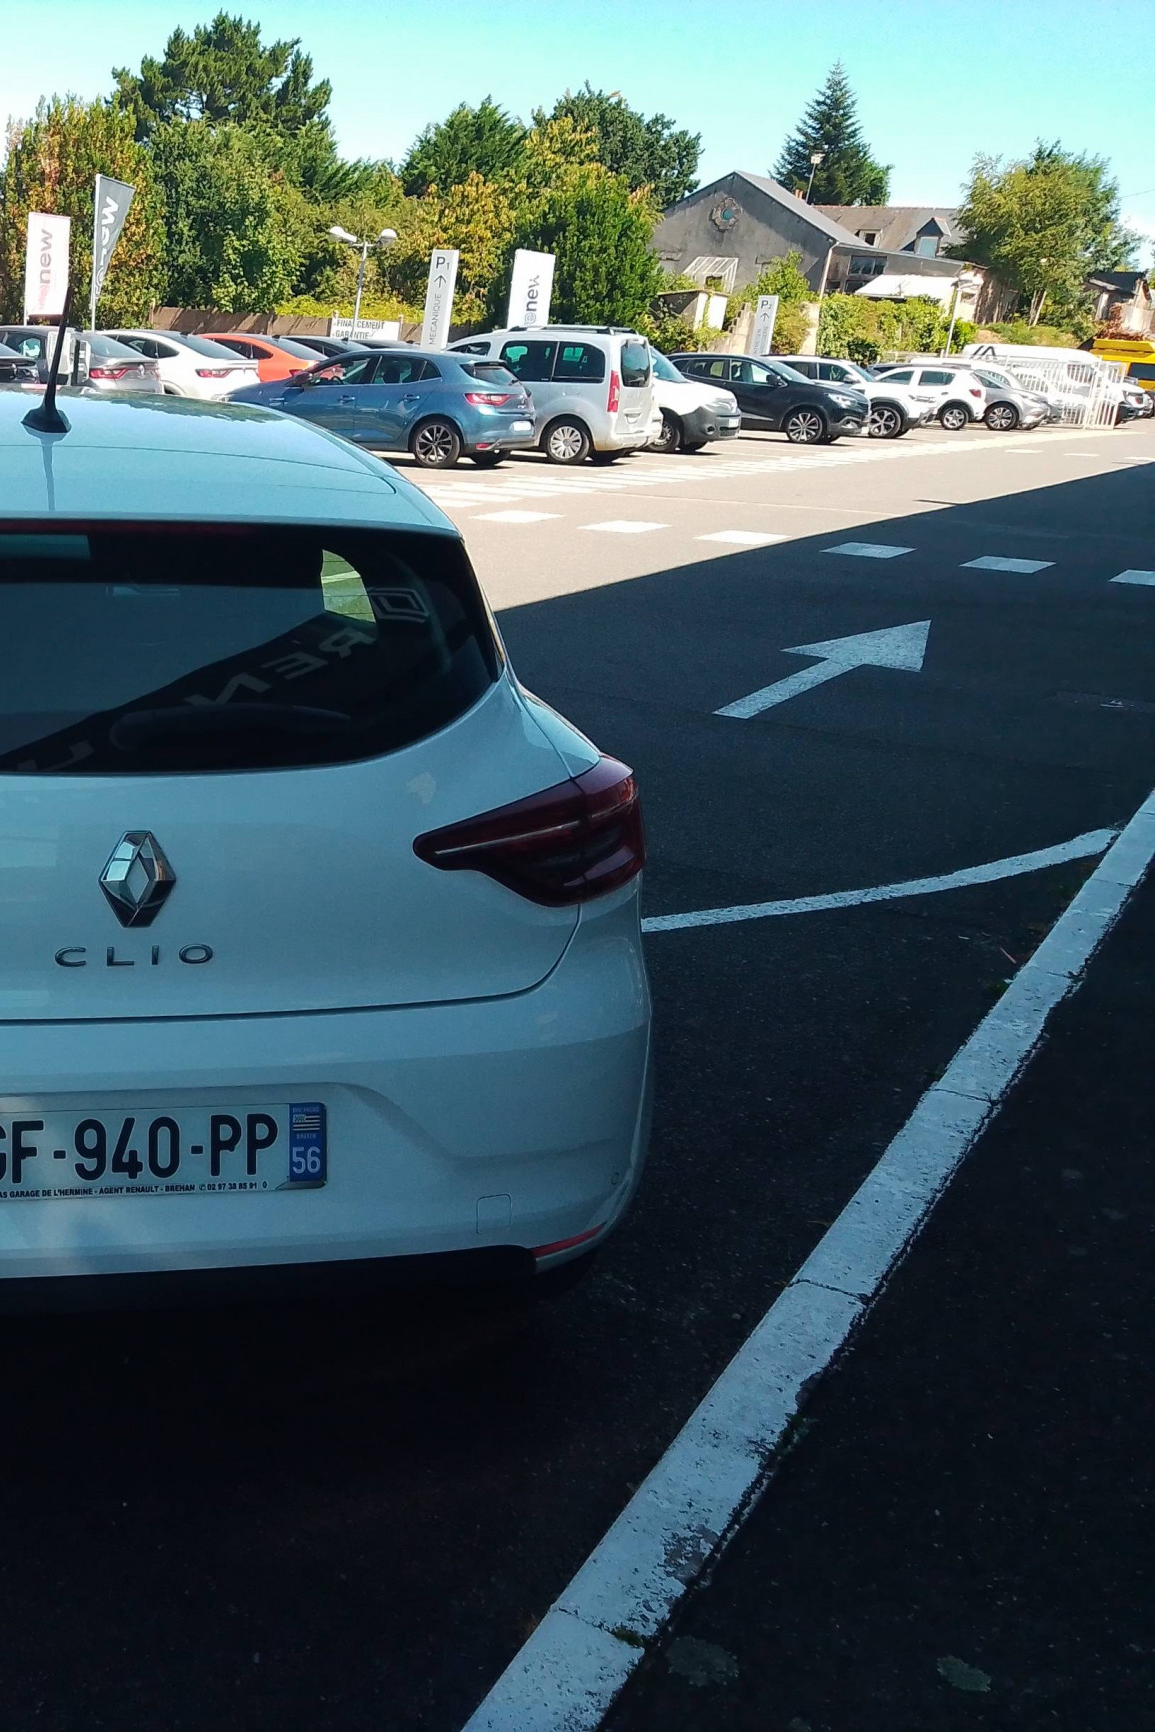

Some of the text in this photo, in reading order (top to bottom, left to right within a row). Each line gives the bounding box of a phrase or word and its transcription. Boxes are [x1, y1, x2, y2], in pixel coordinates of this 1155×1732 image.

[336, 319, 385, 330] FINACEMENT
[428, 292, 443, 345] MECANIQUE
[54, 943, 214, 968] CLIO
[292, 1146, 321, 1174] 56
[10, 1189, 40, 1198] GARAGE
[42, 1189, 52, 1198] DE
[53, 1188, 93, 1197] L'HERMINE
[98, 1187, 123, 1195] AGENT
[125, 1185, 159, 1194] RENAULT
